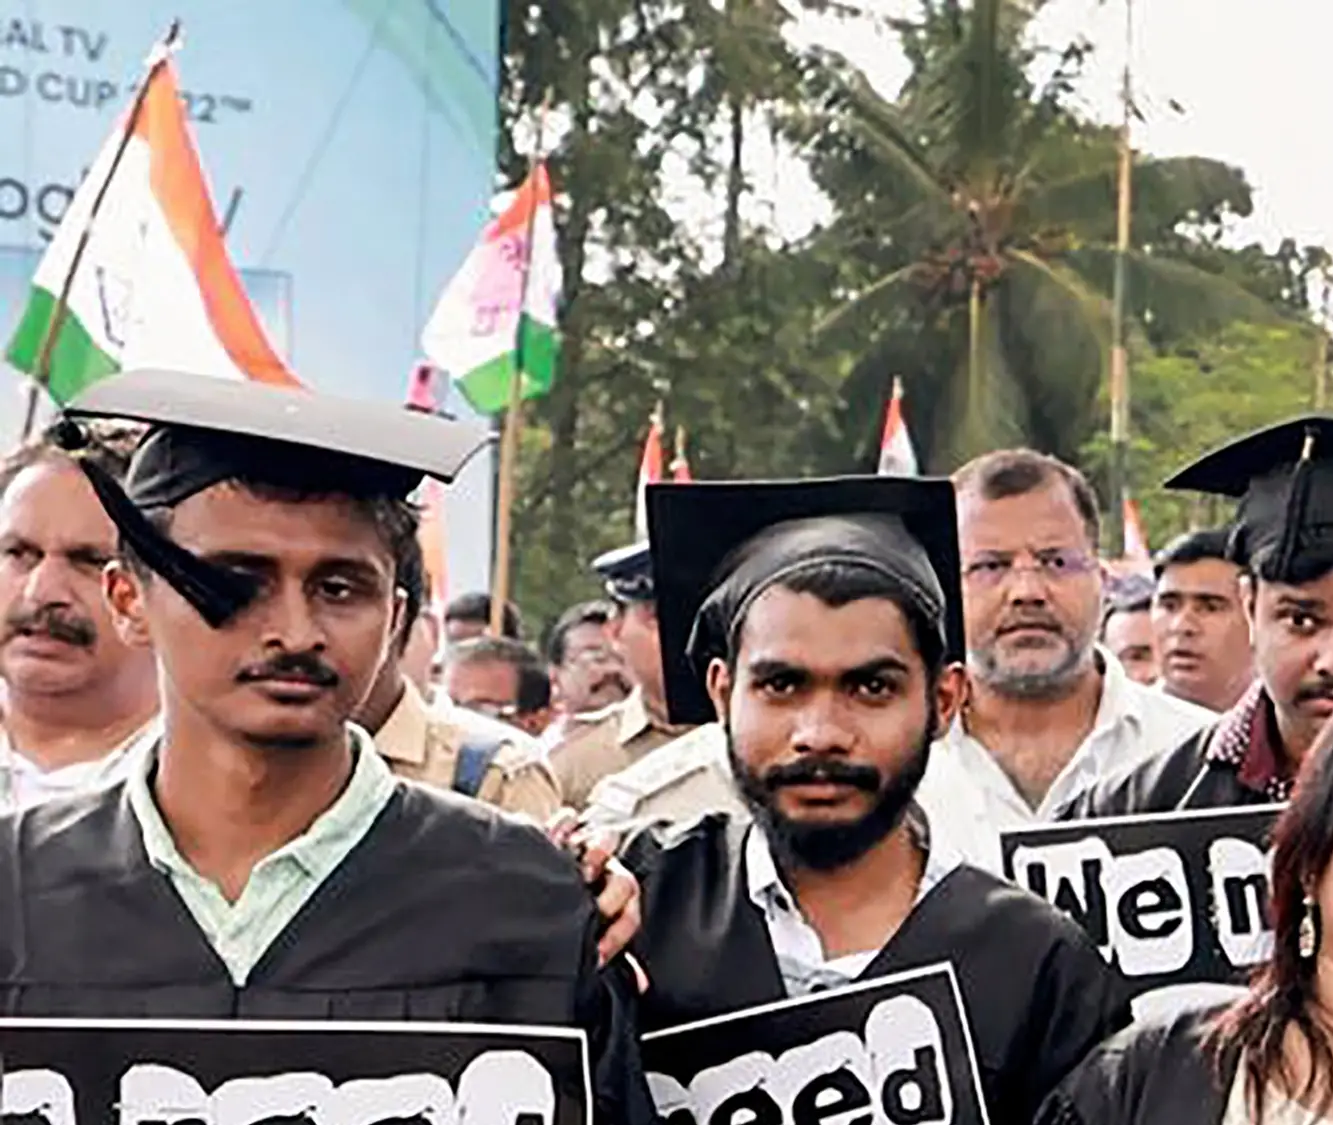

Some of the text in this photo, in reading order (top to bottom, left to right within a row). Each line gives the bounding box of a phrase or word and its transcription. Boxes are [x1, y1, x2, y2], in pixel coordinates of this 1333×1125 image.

[58, 26, 106, 62] TV
[37, 73, 118, 109] CUP
[1026, 857, 1184, 946] We
